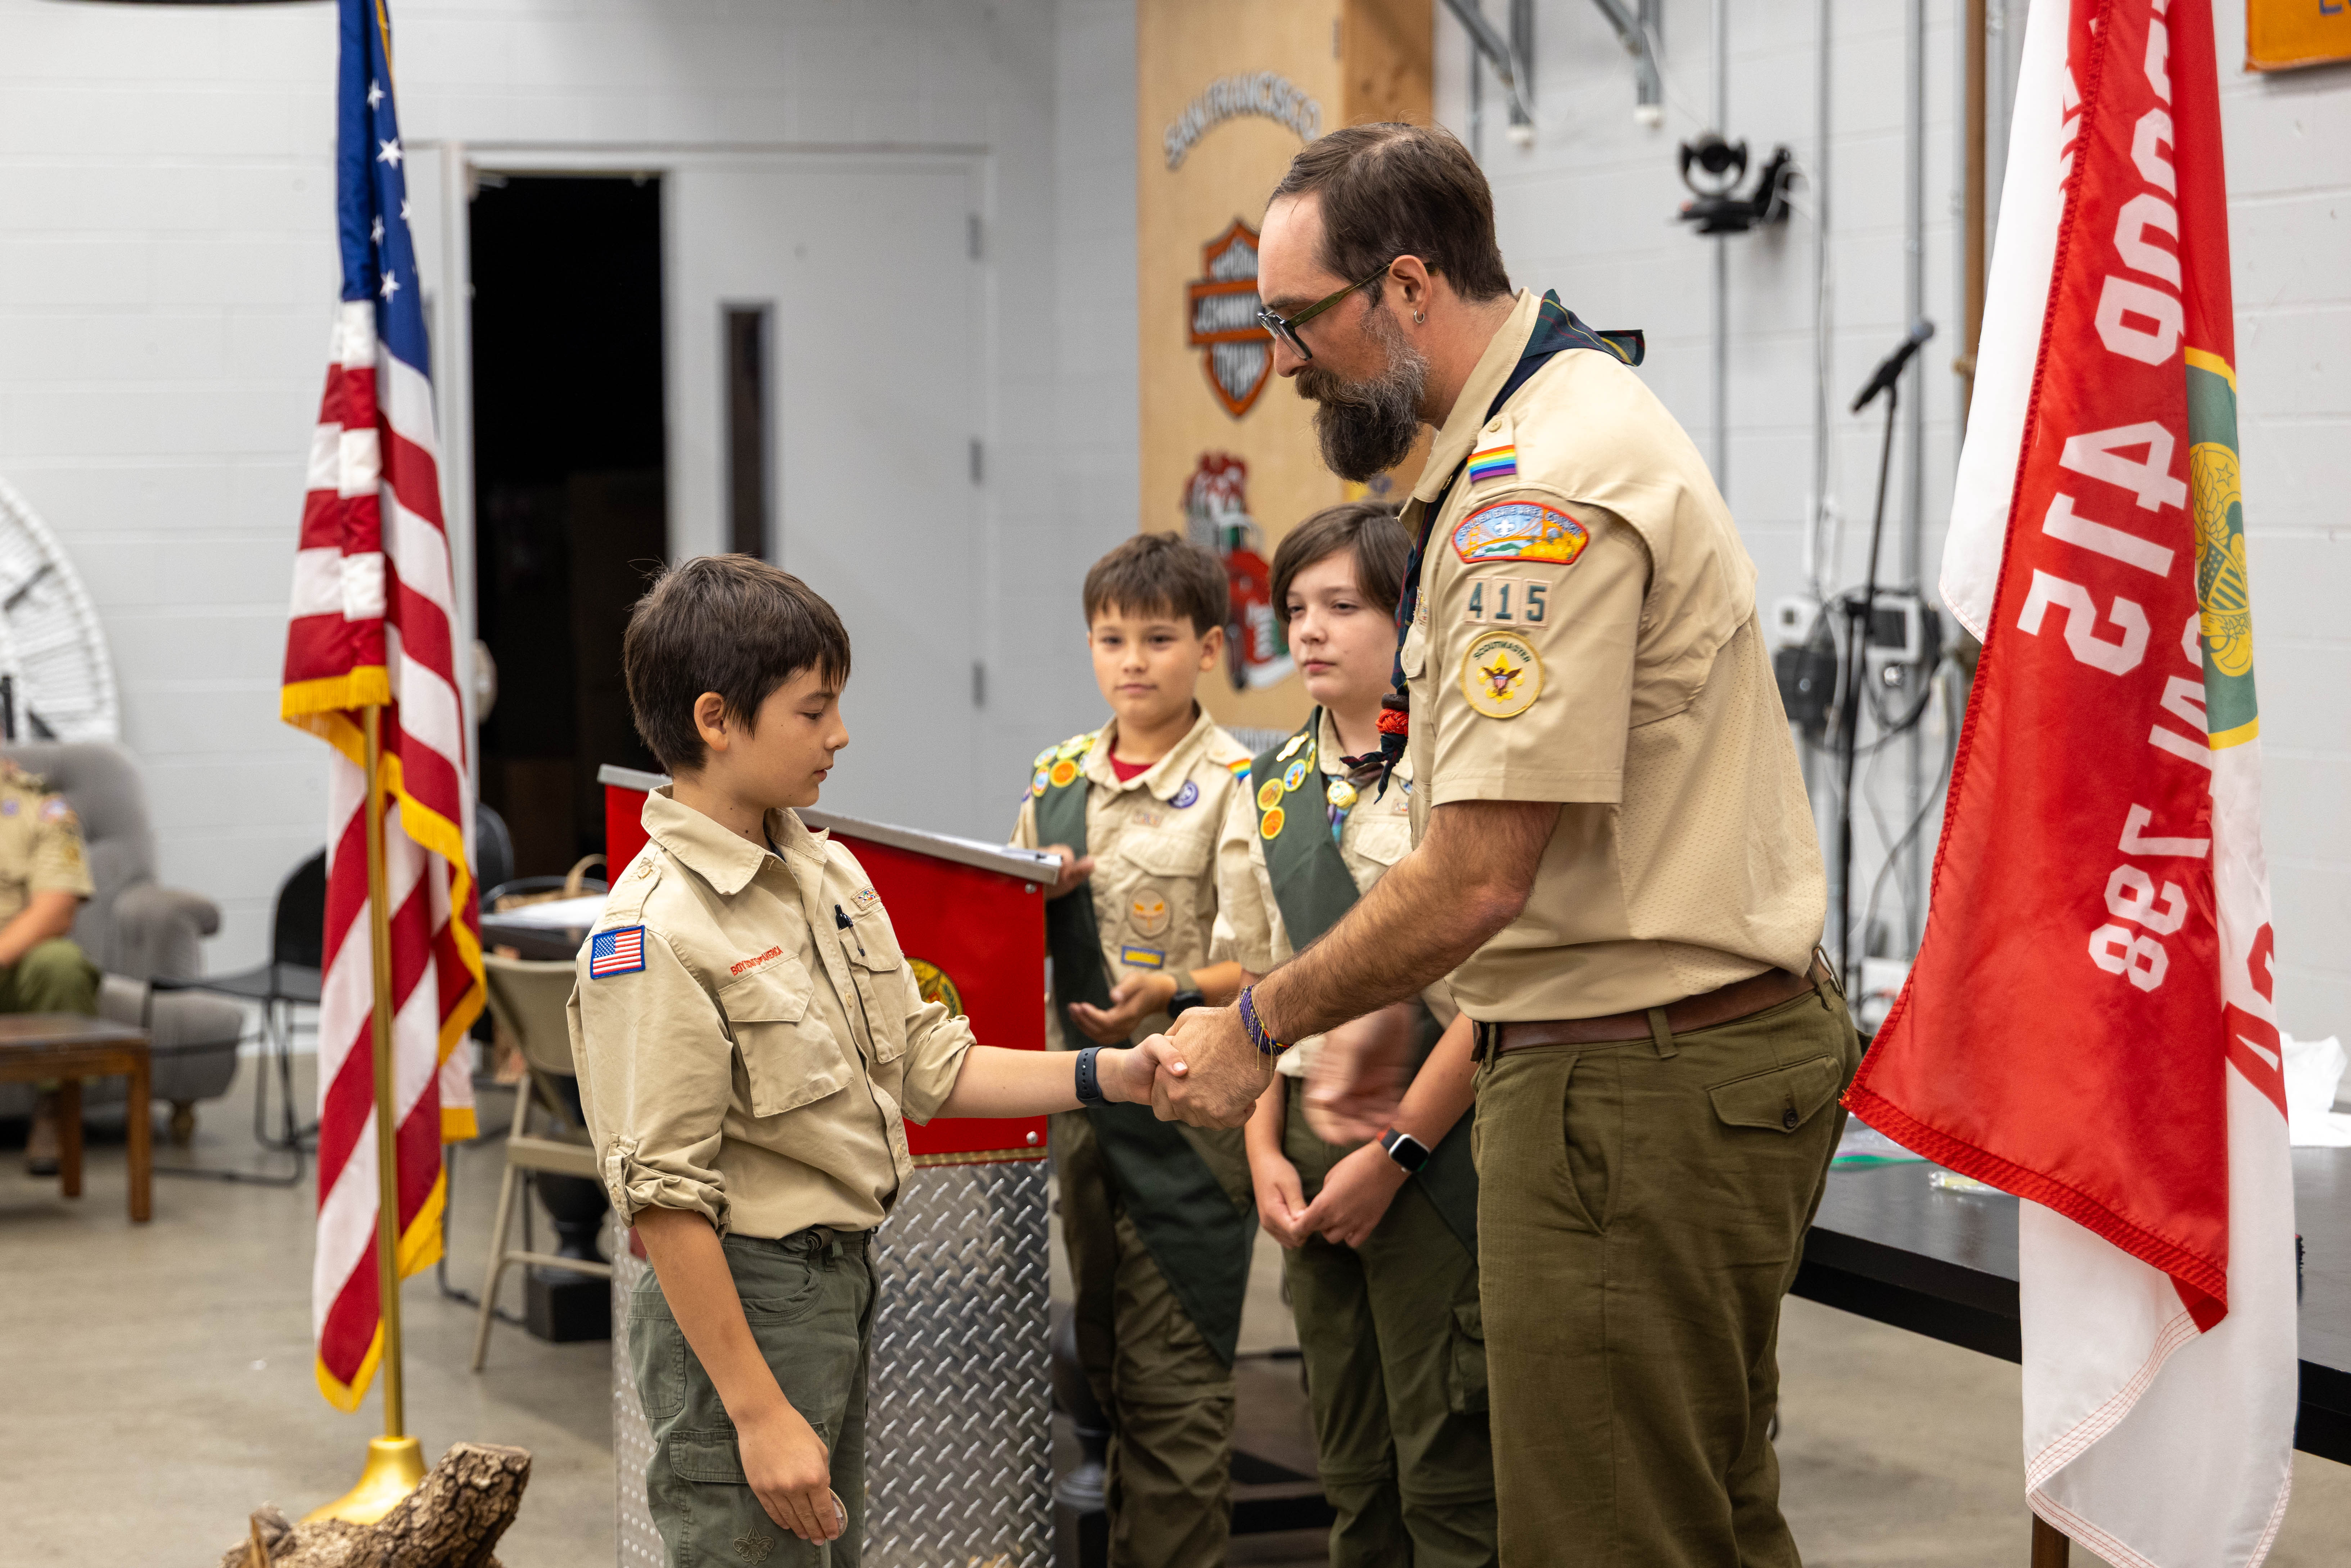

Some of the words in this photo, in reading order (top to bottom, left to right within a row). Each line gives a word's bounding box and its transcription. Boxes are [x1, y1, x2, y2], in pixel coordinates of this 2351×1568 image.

[1469, 582, 1547, 622] 415
[1474, 641, 1531, 662] SCOUTMASTER
[730, 961, 746, 976] BOY
[761, 945, 784, 962] AMERICA
